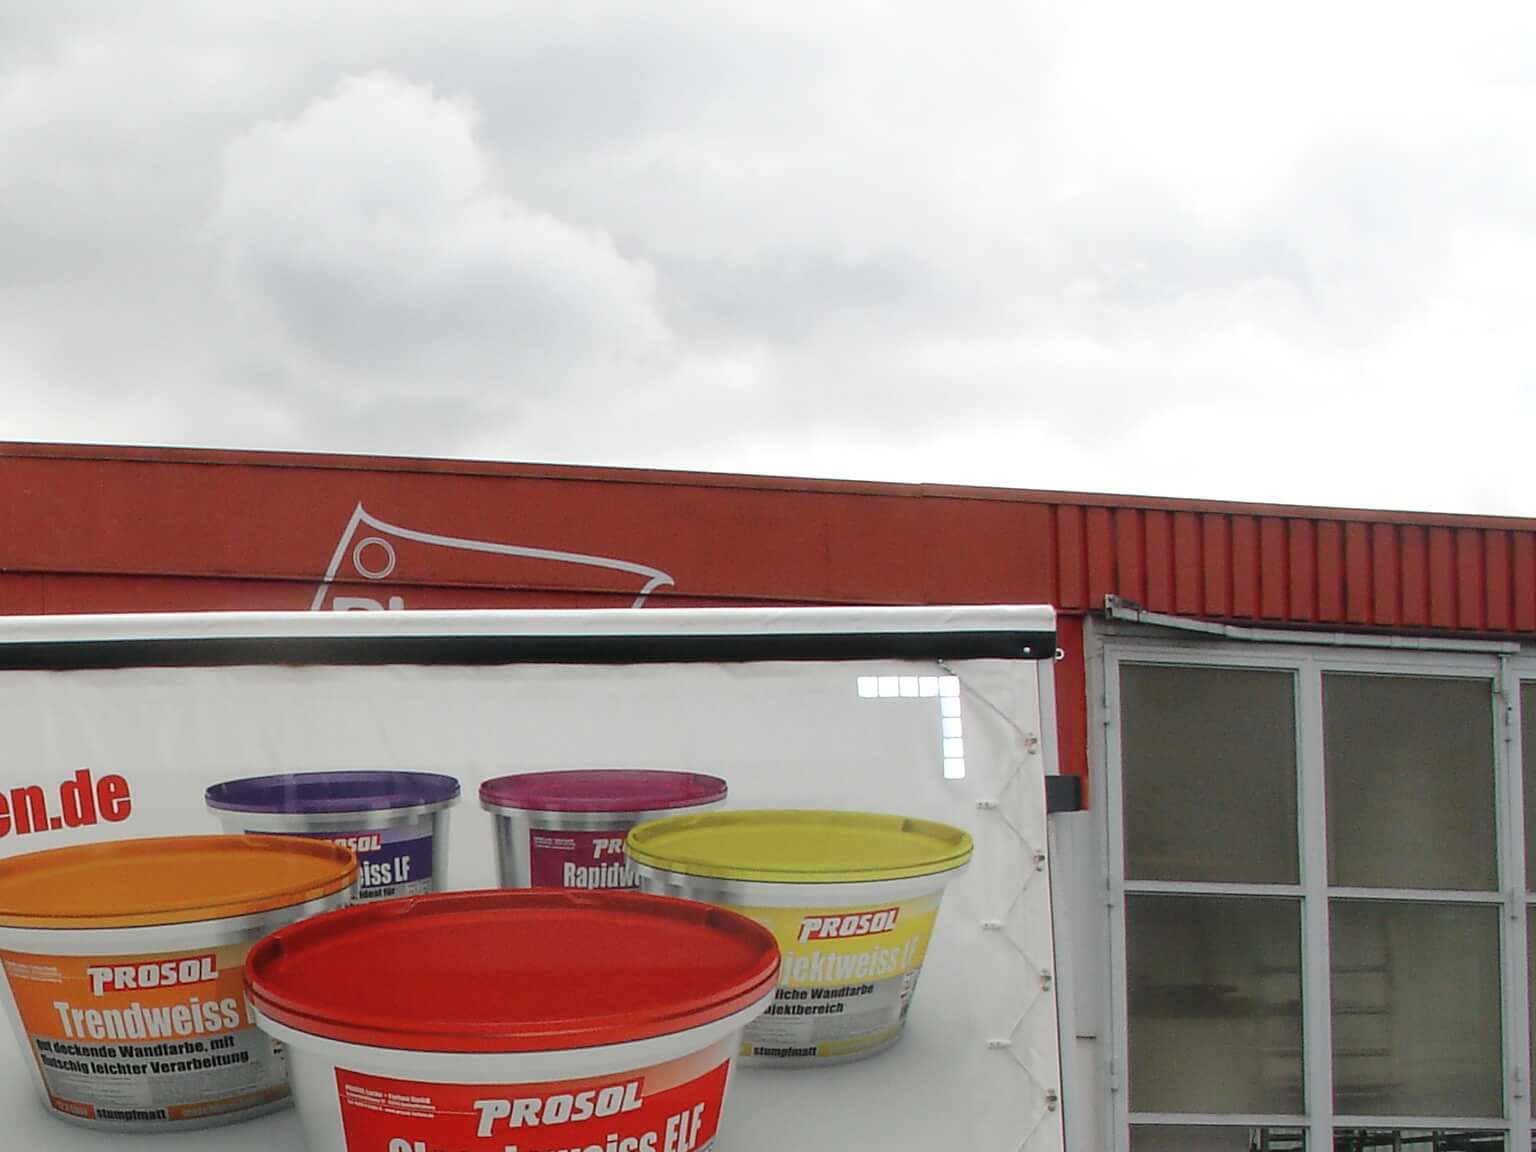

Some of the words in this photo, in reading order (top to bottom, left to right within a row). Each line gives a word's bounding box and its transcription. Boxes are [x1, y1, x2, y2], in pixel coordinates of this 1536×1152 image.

[394, 855, 410, 882] LF
[798, 909, 896, 944] PROSOL
[87, 957, 219, 997] PROSOL
[811, 984, 874, 1000] Wandfarbe
[53, 997, 240, 1041] Trendweiss
[53, 1042, 116, 1058] deckende
[211, 1035, 235, 1050] mit
[91, 1062, 146, 1075] leichter
[153, 1051, 249, 1074] Verarbeitung
[473, 1082, 644, 1138] PROSOL
